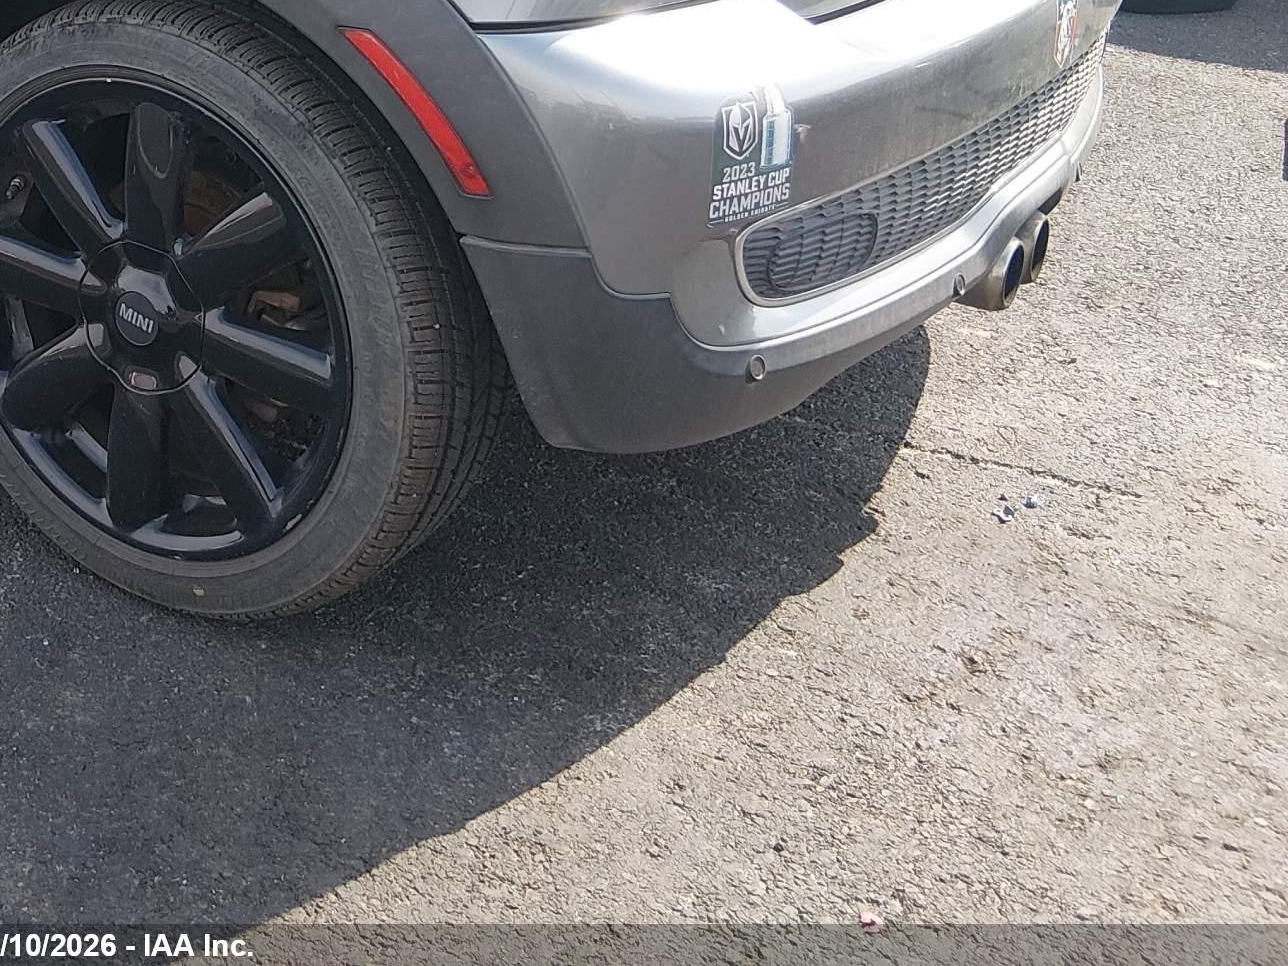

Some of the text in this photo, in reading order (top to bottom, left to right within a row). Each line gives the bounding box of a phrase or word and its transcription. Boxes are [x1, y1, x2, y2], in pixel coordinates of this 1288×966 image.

[712, 167, 790, 201] STANLEY CUP
[722, 161, 755, 183] 2023
[709, 182, 791, 219] CHAMPIONS
[119, 303, 154, 334] MINI
